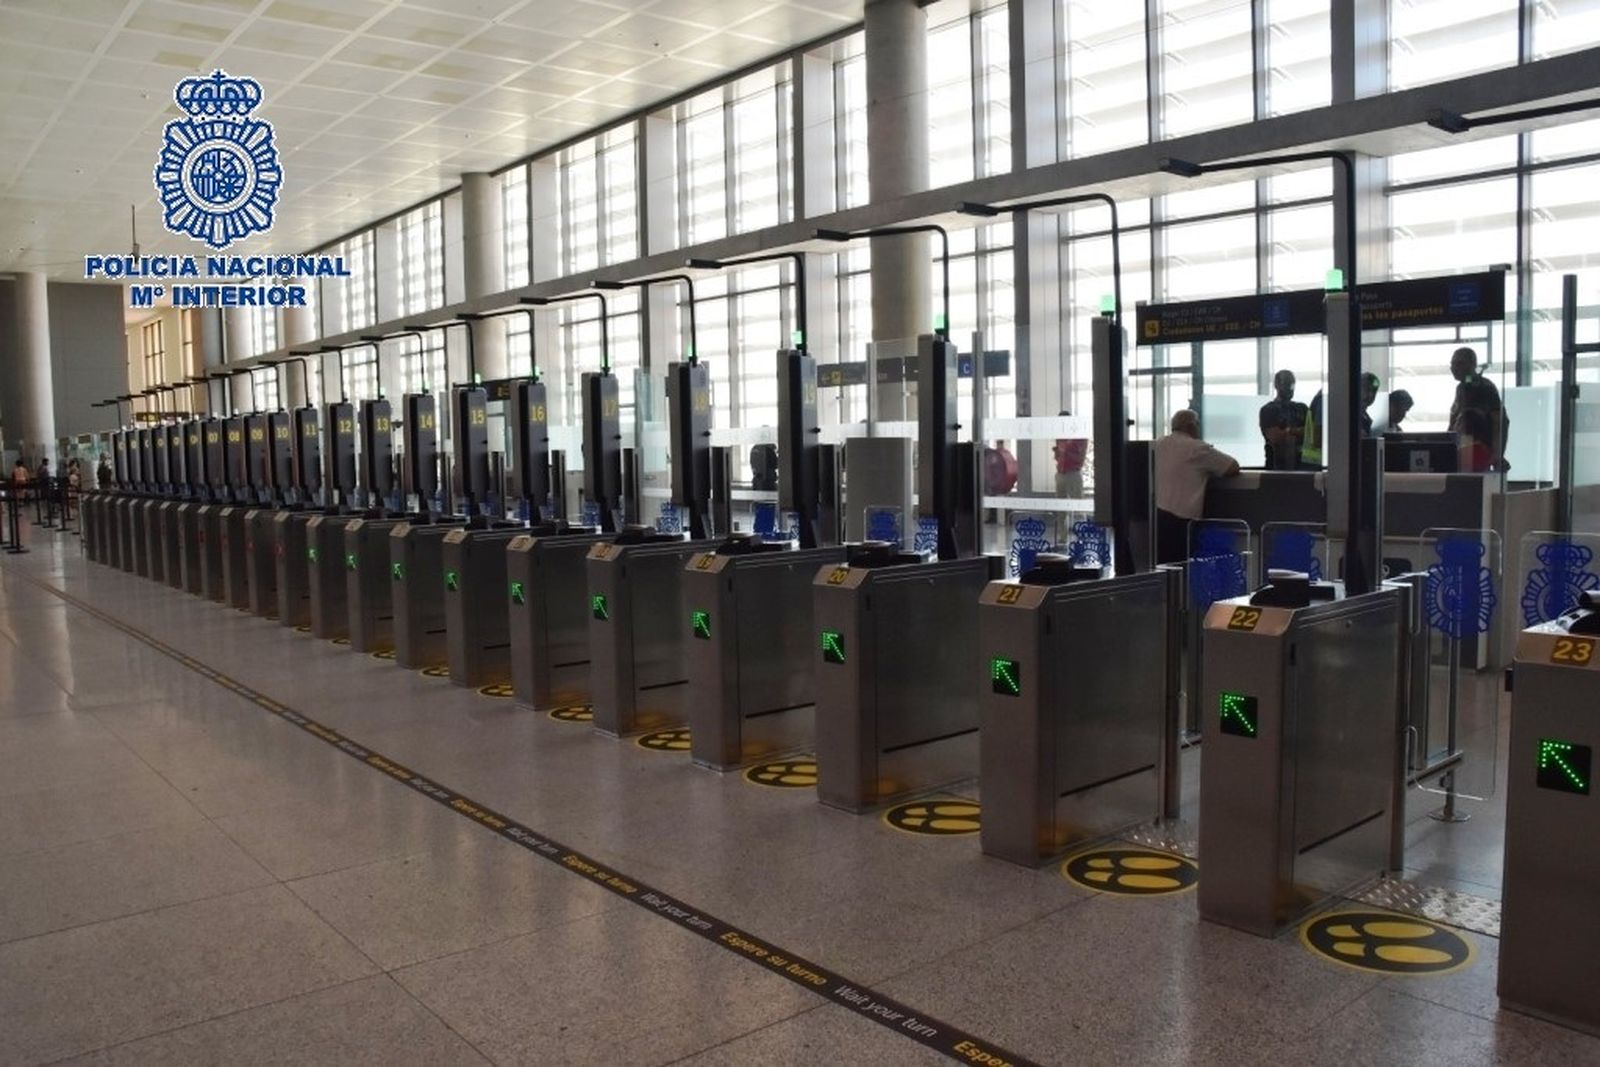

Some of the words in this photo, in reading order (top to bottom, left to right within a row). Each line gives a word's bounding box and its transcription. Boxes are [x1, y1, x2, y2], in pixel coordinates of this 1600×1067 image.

[472, 410, 485, 424] 15
[531, 406, 545, 421] 16
[339, 420, 351, 432] 12
[376, 418, 389, 431] 13
[420, 415, 433, 428] 14
[229, 431, 240, 442] 08
[276, 427, 288, 438] 10
[306, 424, 317, 436] 11
[1000, 586, 1021, 602] 21
[1230, 610, 1259, 627] 22
[1553, 640, 1592, 661] 23
[720, 932, 769, 957] Espere
[767, 955, 788, 967] su
[786, 962, 828, 985] turno
[834, 985, 869, 1005] Wait
[862, 1002, 904, 1021] your
[902, 1017, 938, 1038] turn
